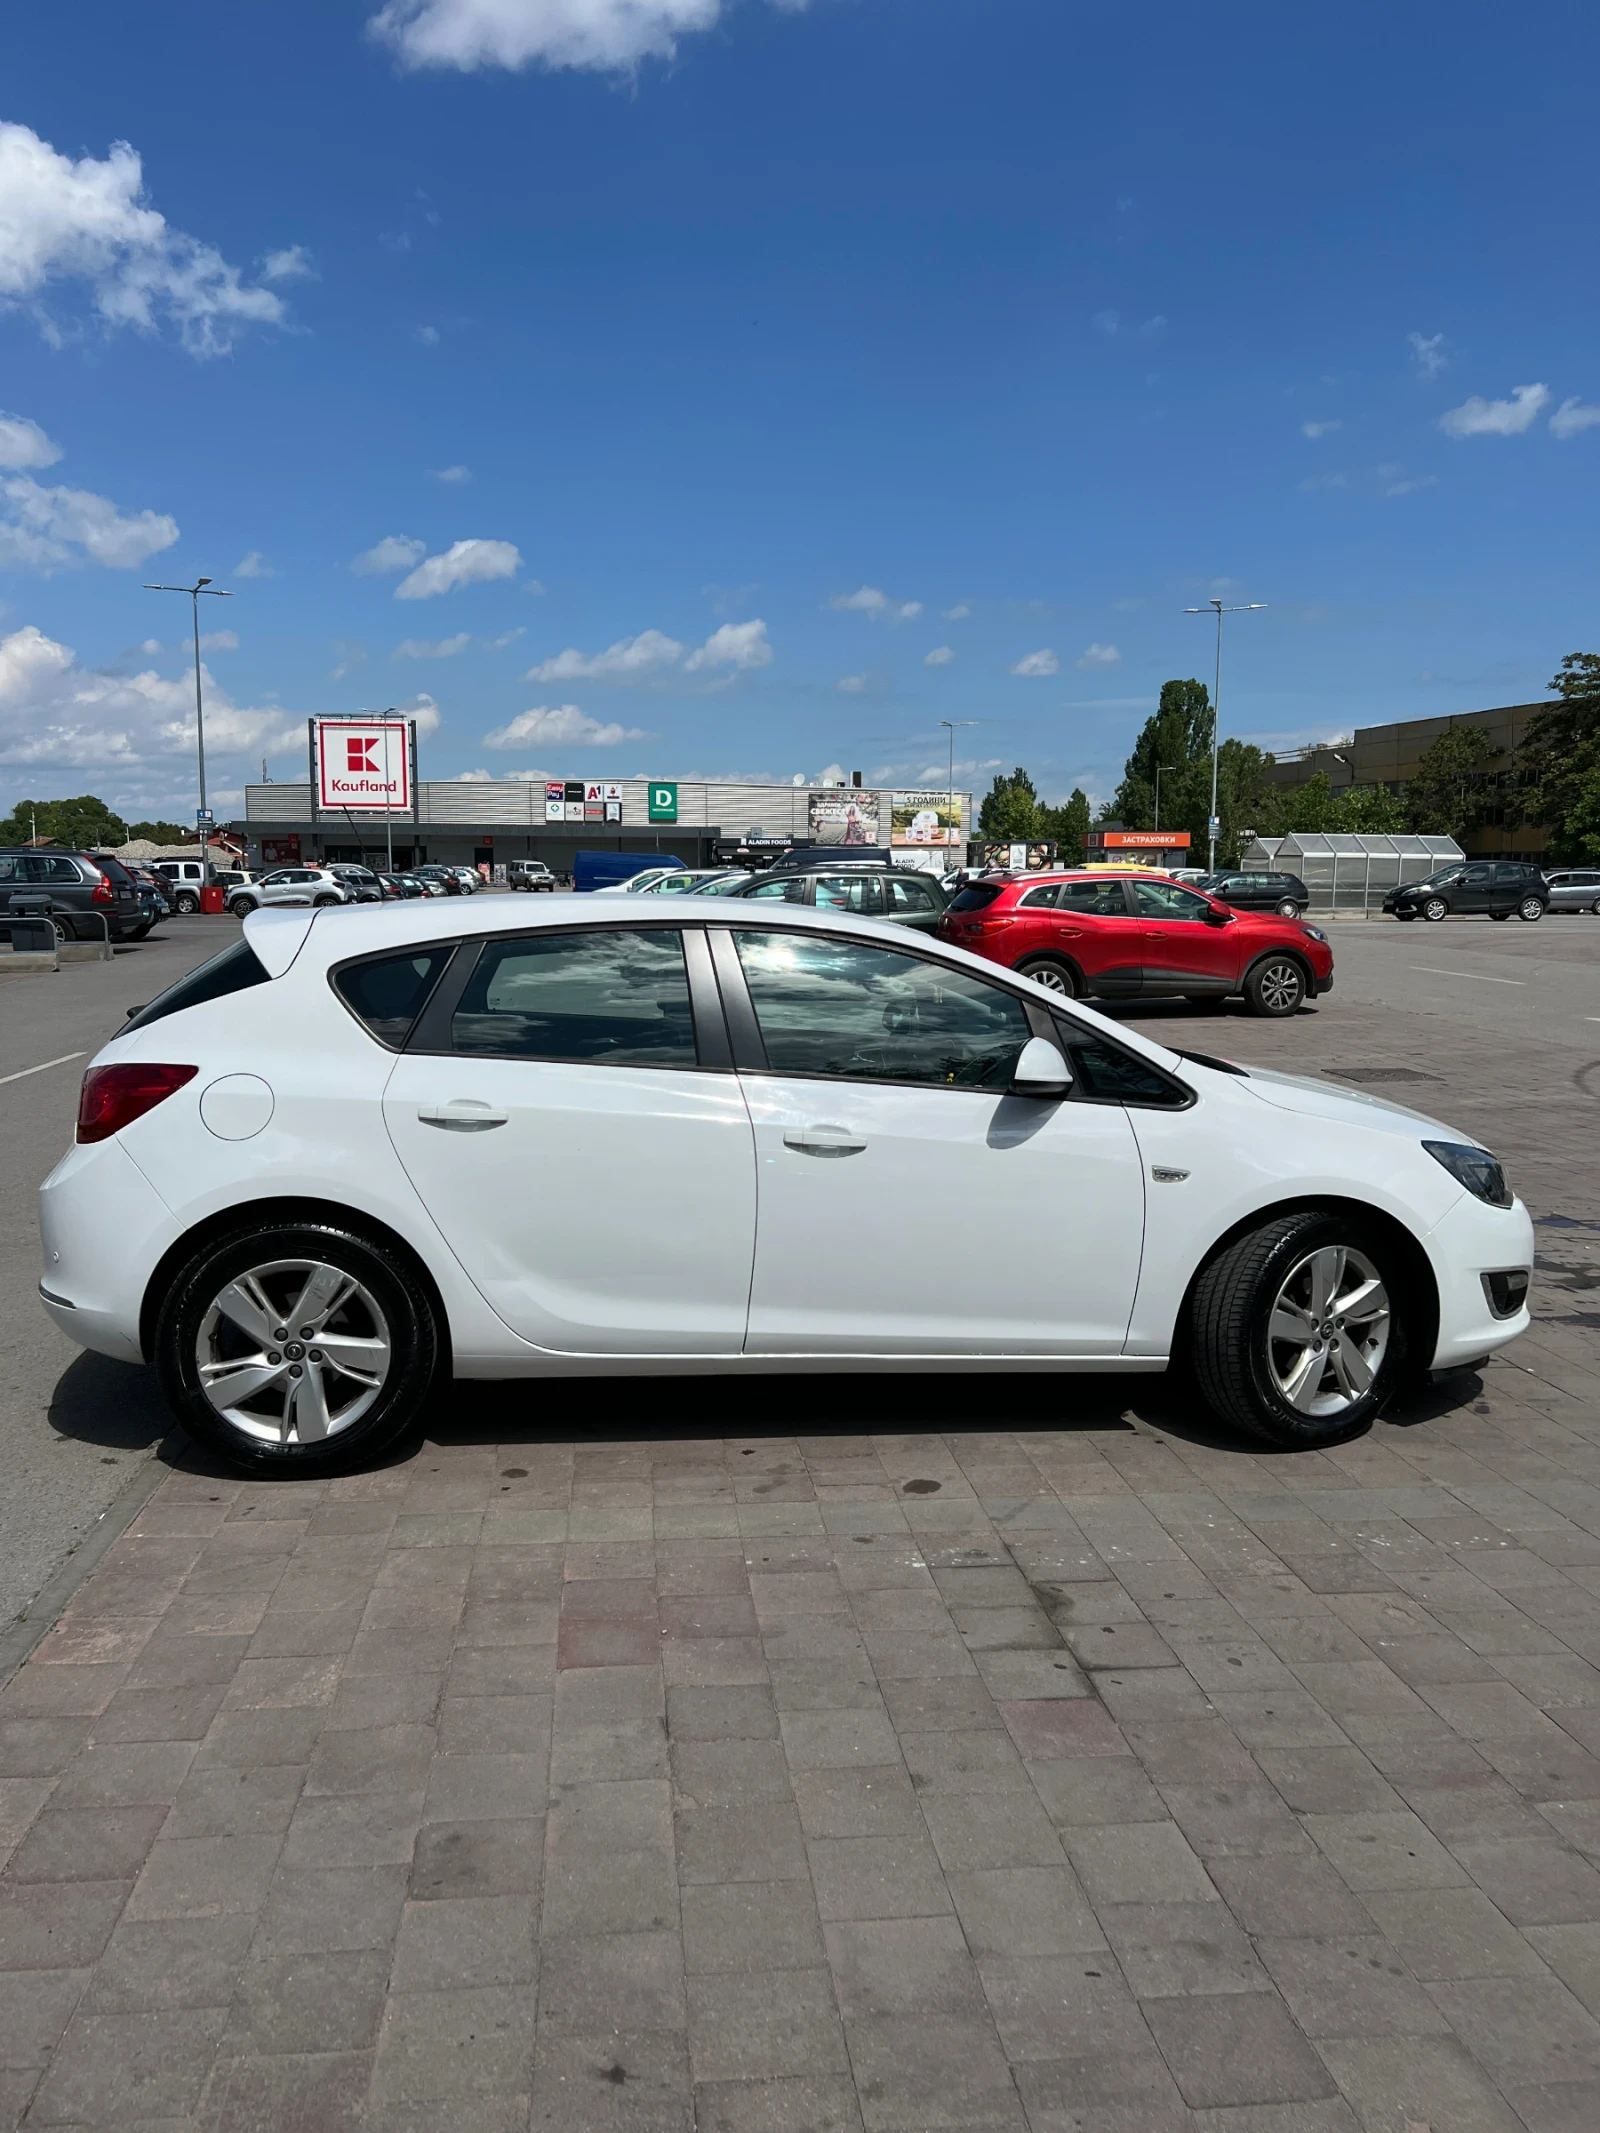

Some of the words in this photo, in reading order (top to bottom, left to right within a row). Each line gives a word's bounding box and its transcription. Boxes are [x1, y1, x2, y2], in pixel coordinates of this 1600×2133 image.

[332, 780, 396, 791] Kaufland
[547, 784, 563, 792] Easy
[587, 785, 601, 799] A1
